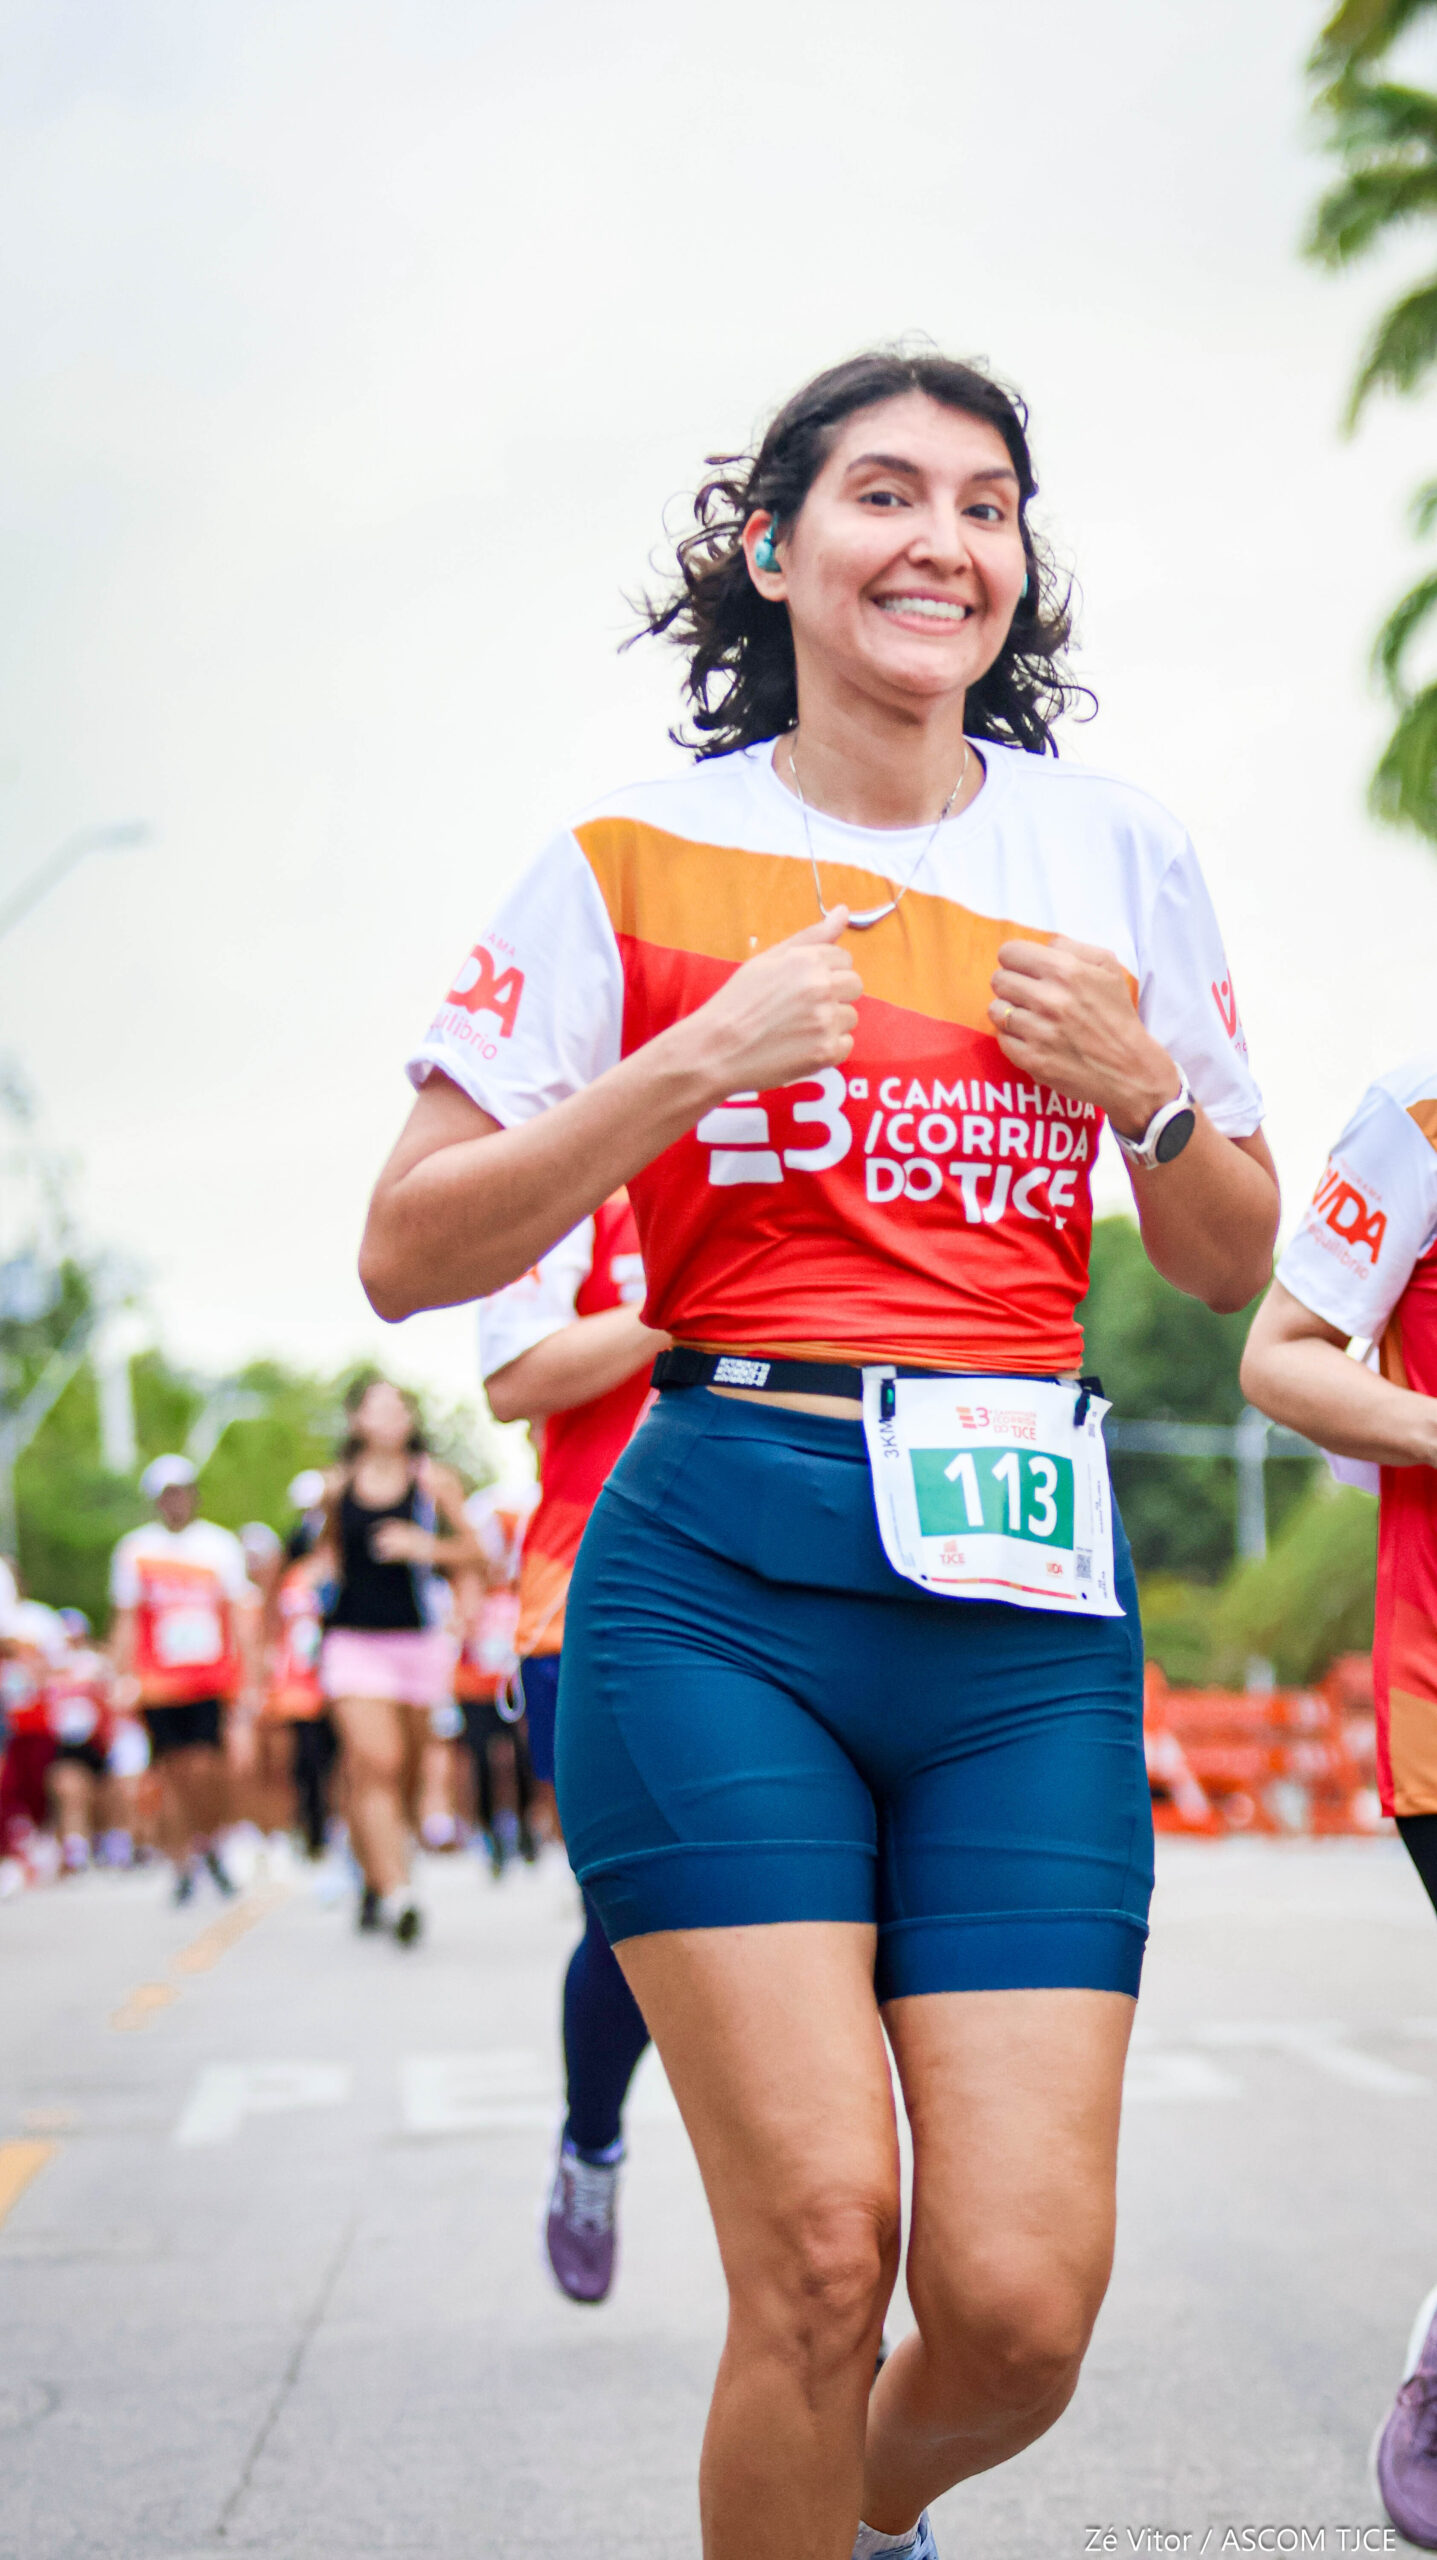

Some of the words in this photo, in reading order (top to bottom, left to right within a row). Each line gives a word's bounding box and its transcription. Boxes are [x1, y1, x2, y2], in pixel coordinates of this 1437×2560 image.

[878, 1077, 1096, 1119] CAMINHADA
[865, 1157, 944, 1203] DO
[949, 1161, 1078, 1230] TJCE
[878, 1417, 899, 1458] 3KM
[943, 1452, 1058, 1537] 113
